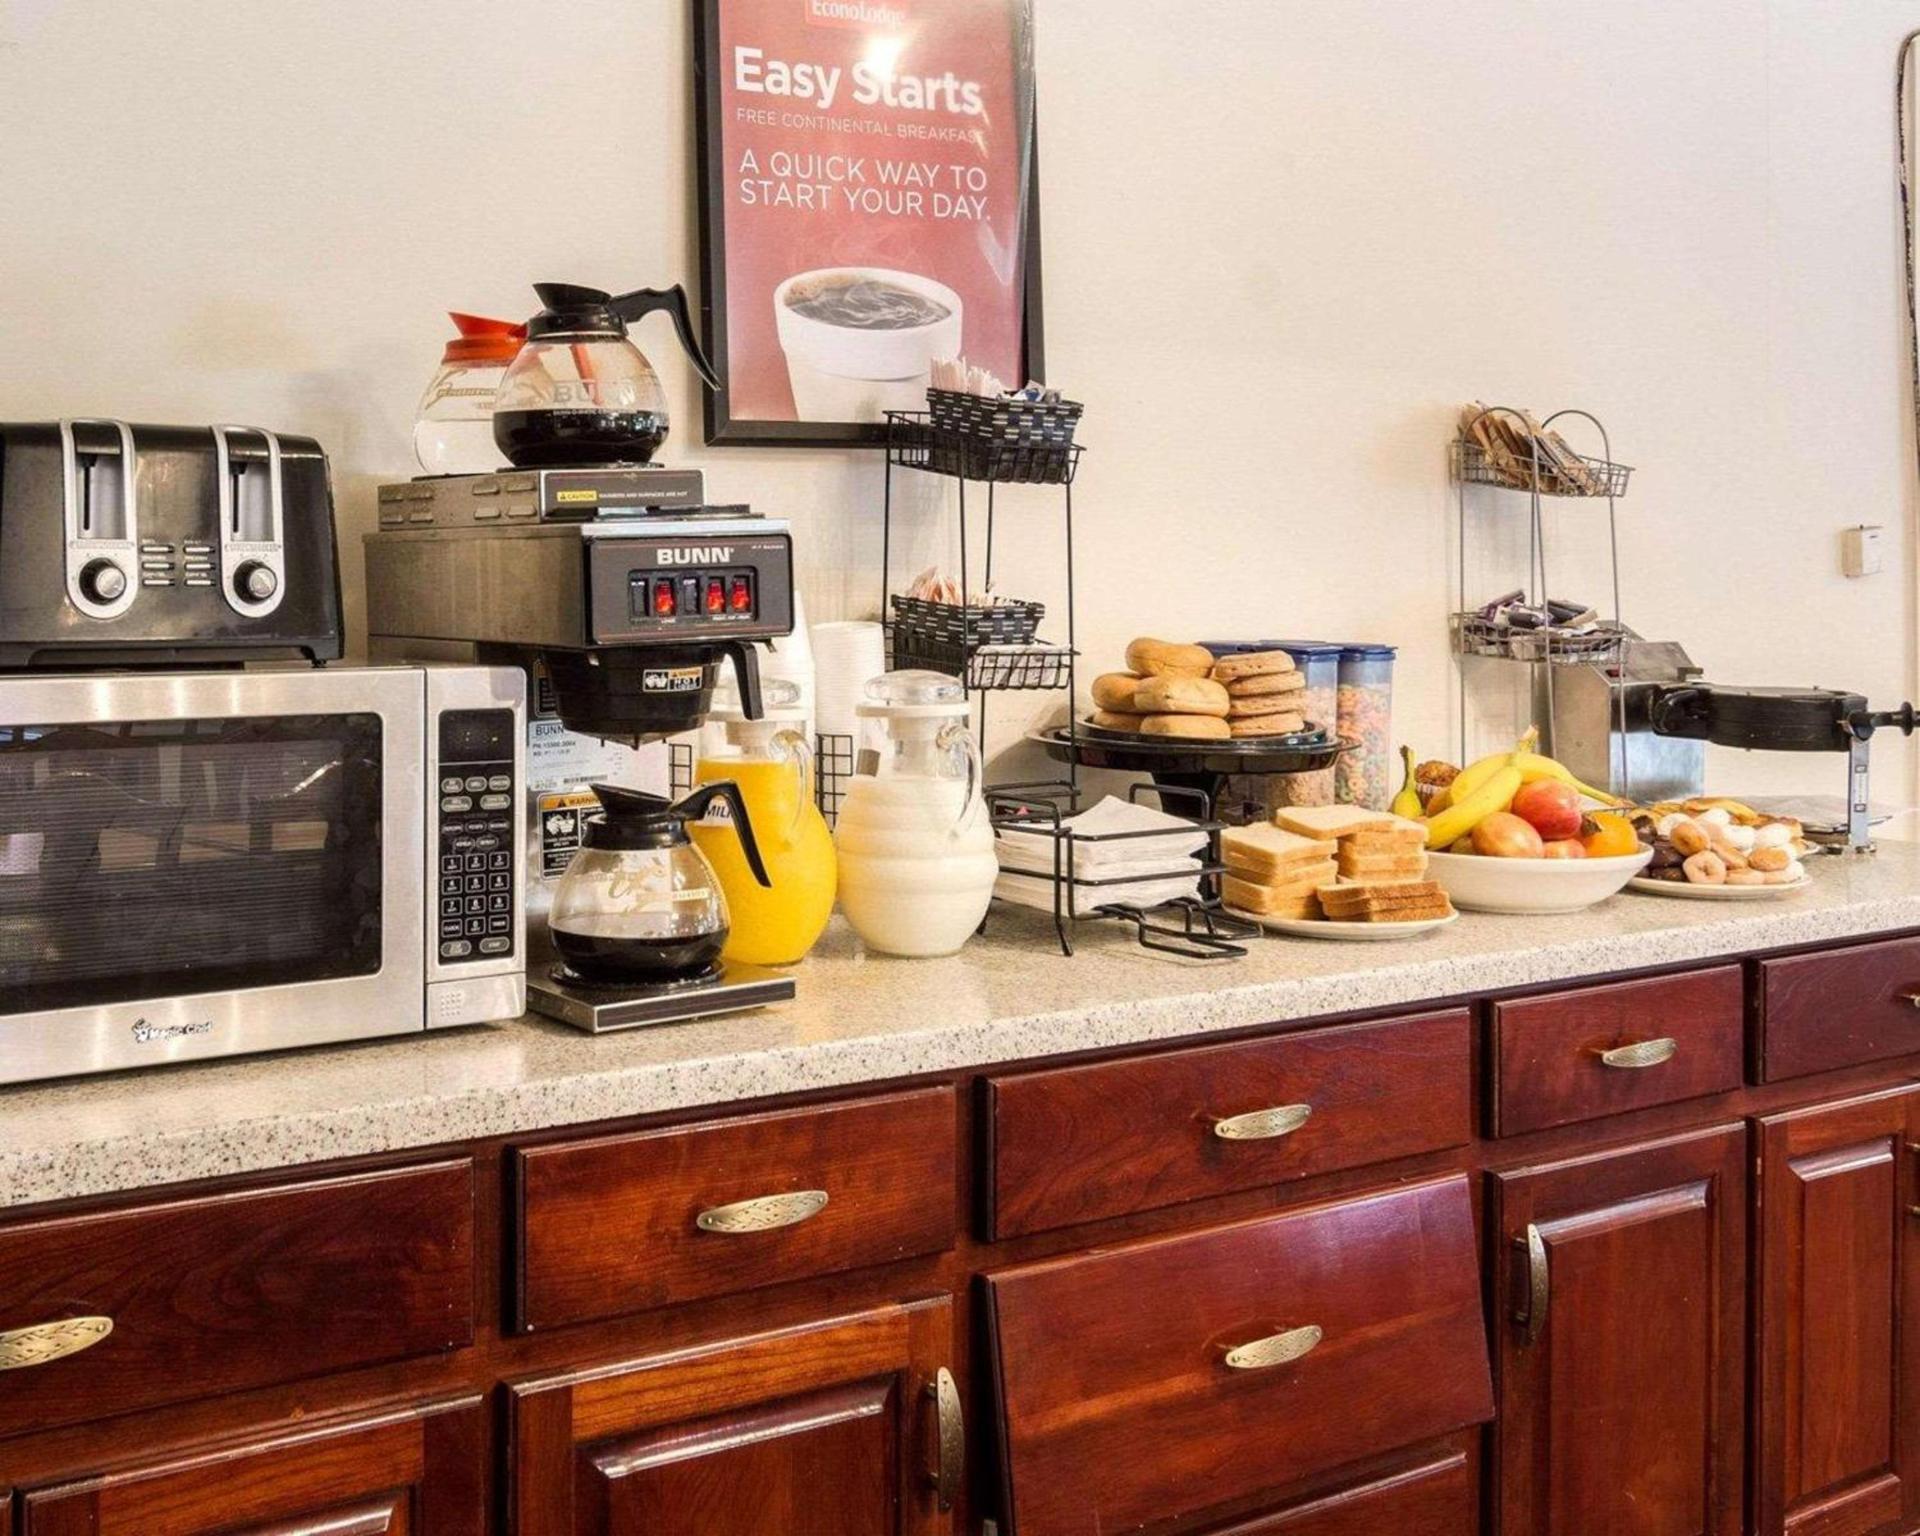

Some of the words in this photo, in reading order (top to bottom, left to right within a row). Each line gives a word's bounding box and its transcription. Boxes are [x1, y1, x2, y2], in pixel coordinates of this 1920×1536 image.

[735, 46, 841, 109] Easy
[852, 60, 983, 115] Starts
[736, 107, 777, 126] FREE
[782, 112, 892, 137] CONTINENTAL
[739, 149, 759, 174] A
[770, 151, 866, 184] QUICK
[875, 159, 940, 187] WAY
[950, 165, 988, 192] TO
[740, 179, 832, 210] START
[843, 187, 924, 217] YOUR
[933, 193, 991, 221] DAY.
[656, 547, 730, 565] BUNN
[535, 725, 564, 736] BUNN
